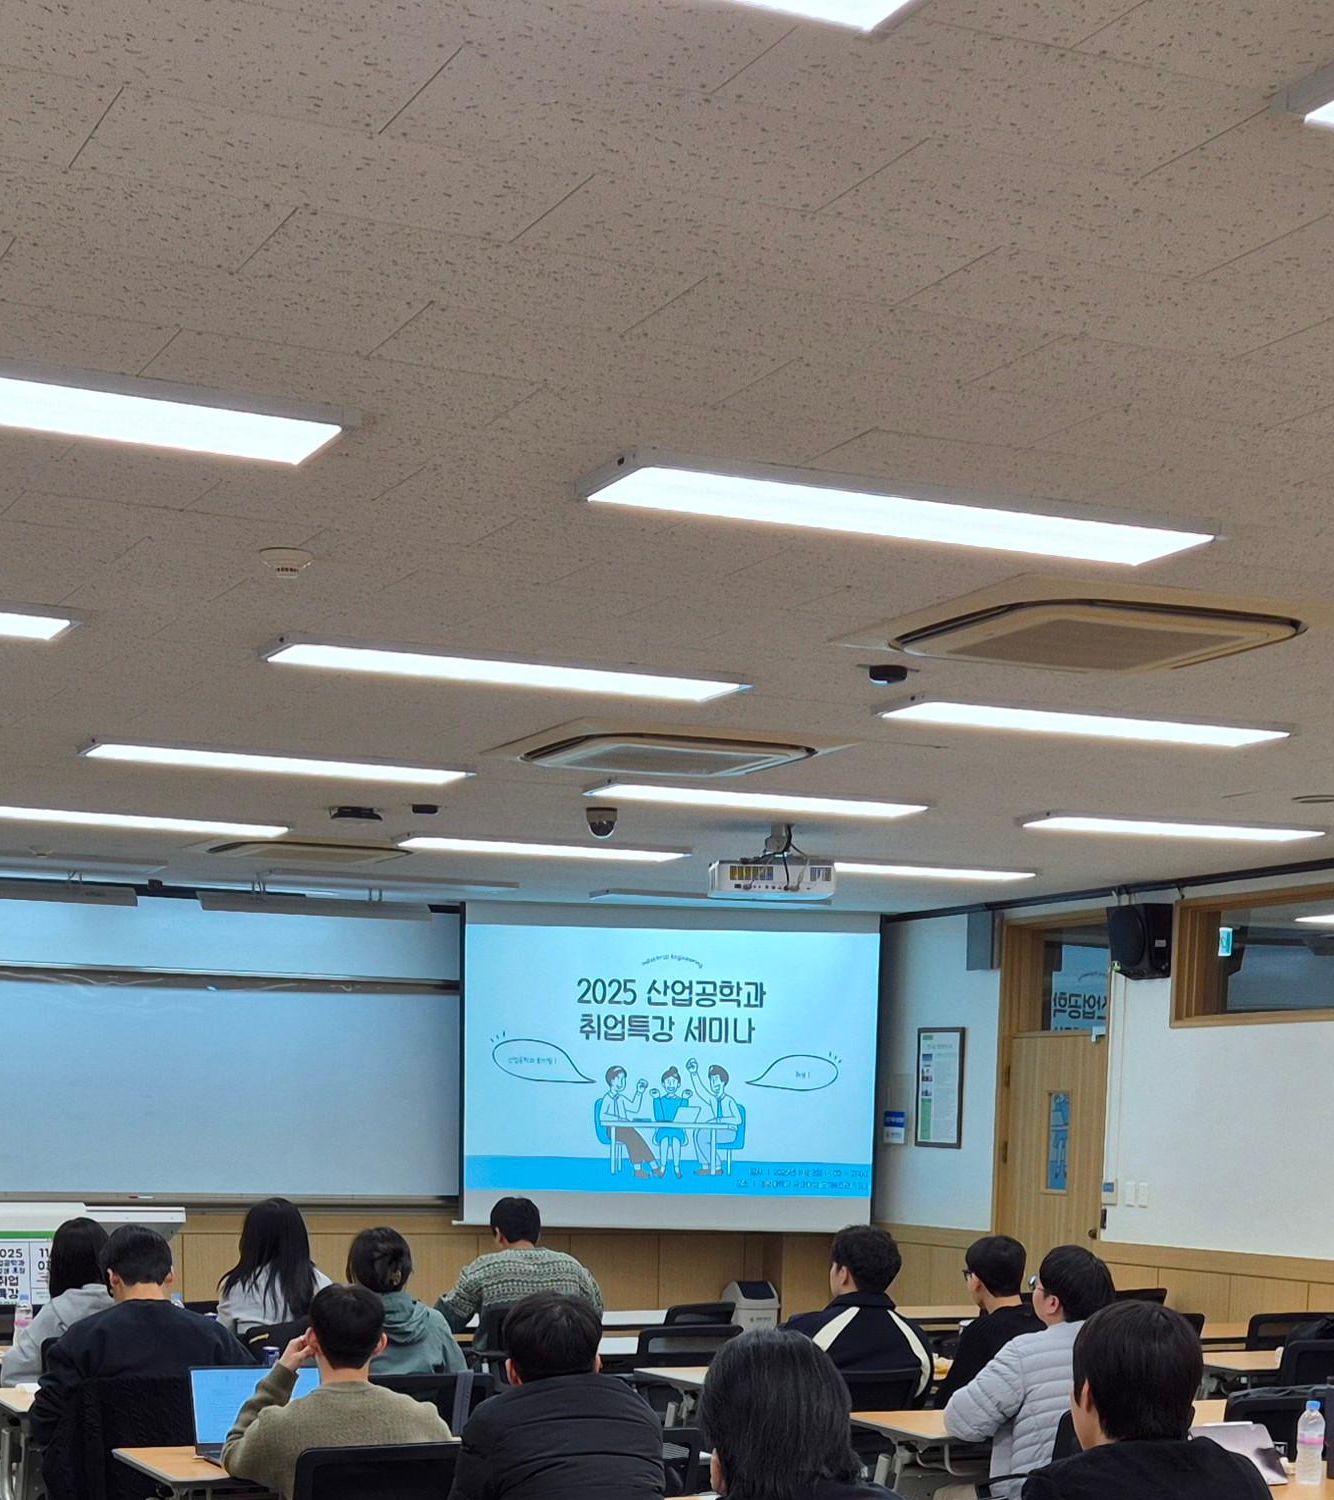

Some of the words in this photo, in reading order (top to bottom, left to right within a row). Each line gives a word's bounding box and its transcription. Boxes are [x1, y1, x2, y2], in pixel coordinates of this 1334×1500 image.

[577, 978, 637, 1006] 2025
[647, 979, 766, 1008] 산업공학과
[579, 1014, 675, 1043] 취업특강
[684, 1016, 755, 1044] 세미나
